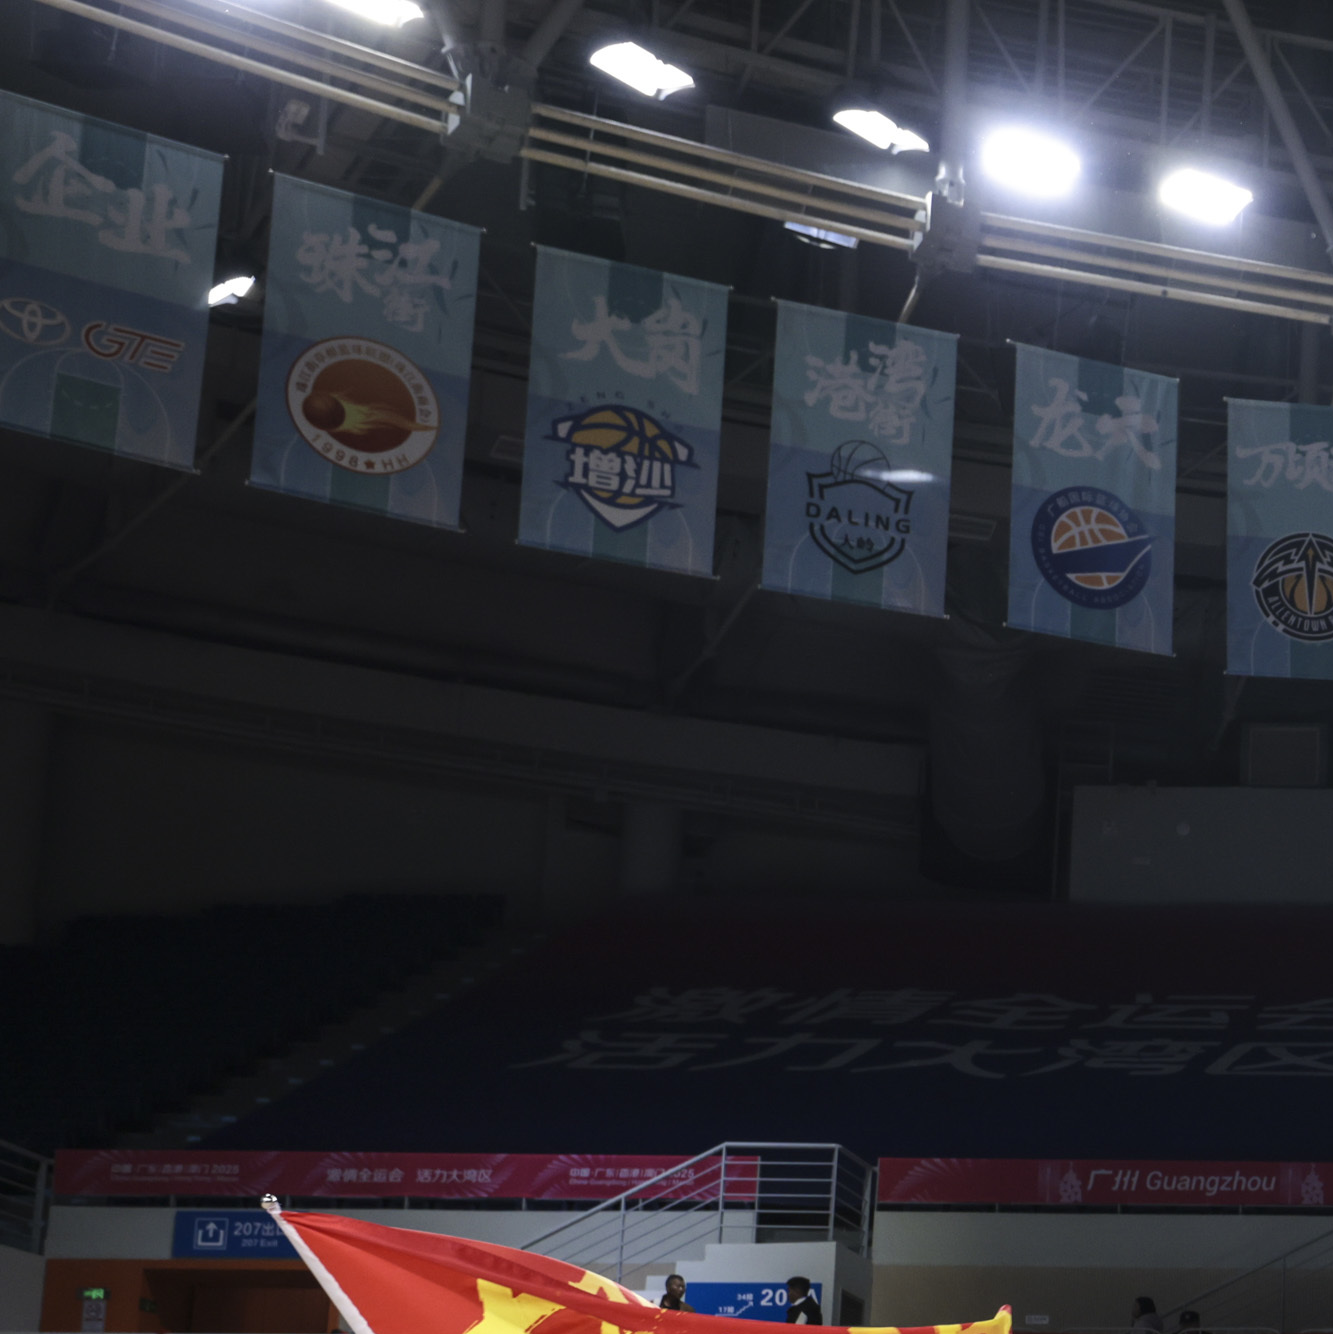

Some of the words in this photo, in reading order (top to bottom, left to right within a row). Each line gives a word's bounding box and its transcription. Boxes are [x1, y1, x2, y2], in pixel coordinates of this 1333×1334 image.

[12, 129, 192, 265] 企业
[83, 321, 186, 374] GTE
[568, 446, 674, 497] 增沙
[805, 502, 912, 536] DALING
[1145, 1169, 1277, 1194] Guangzhou
